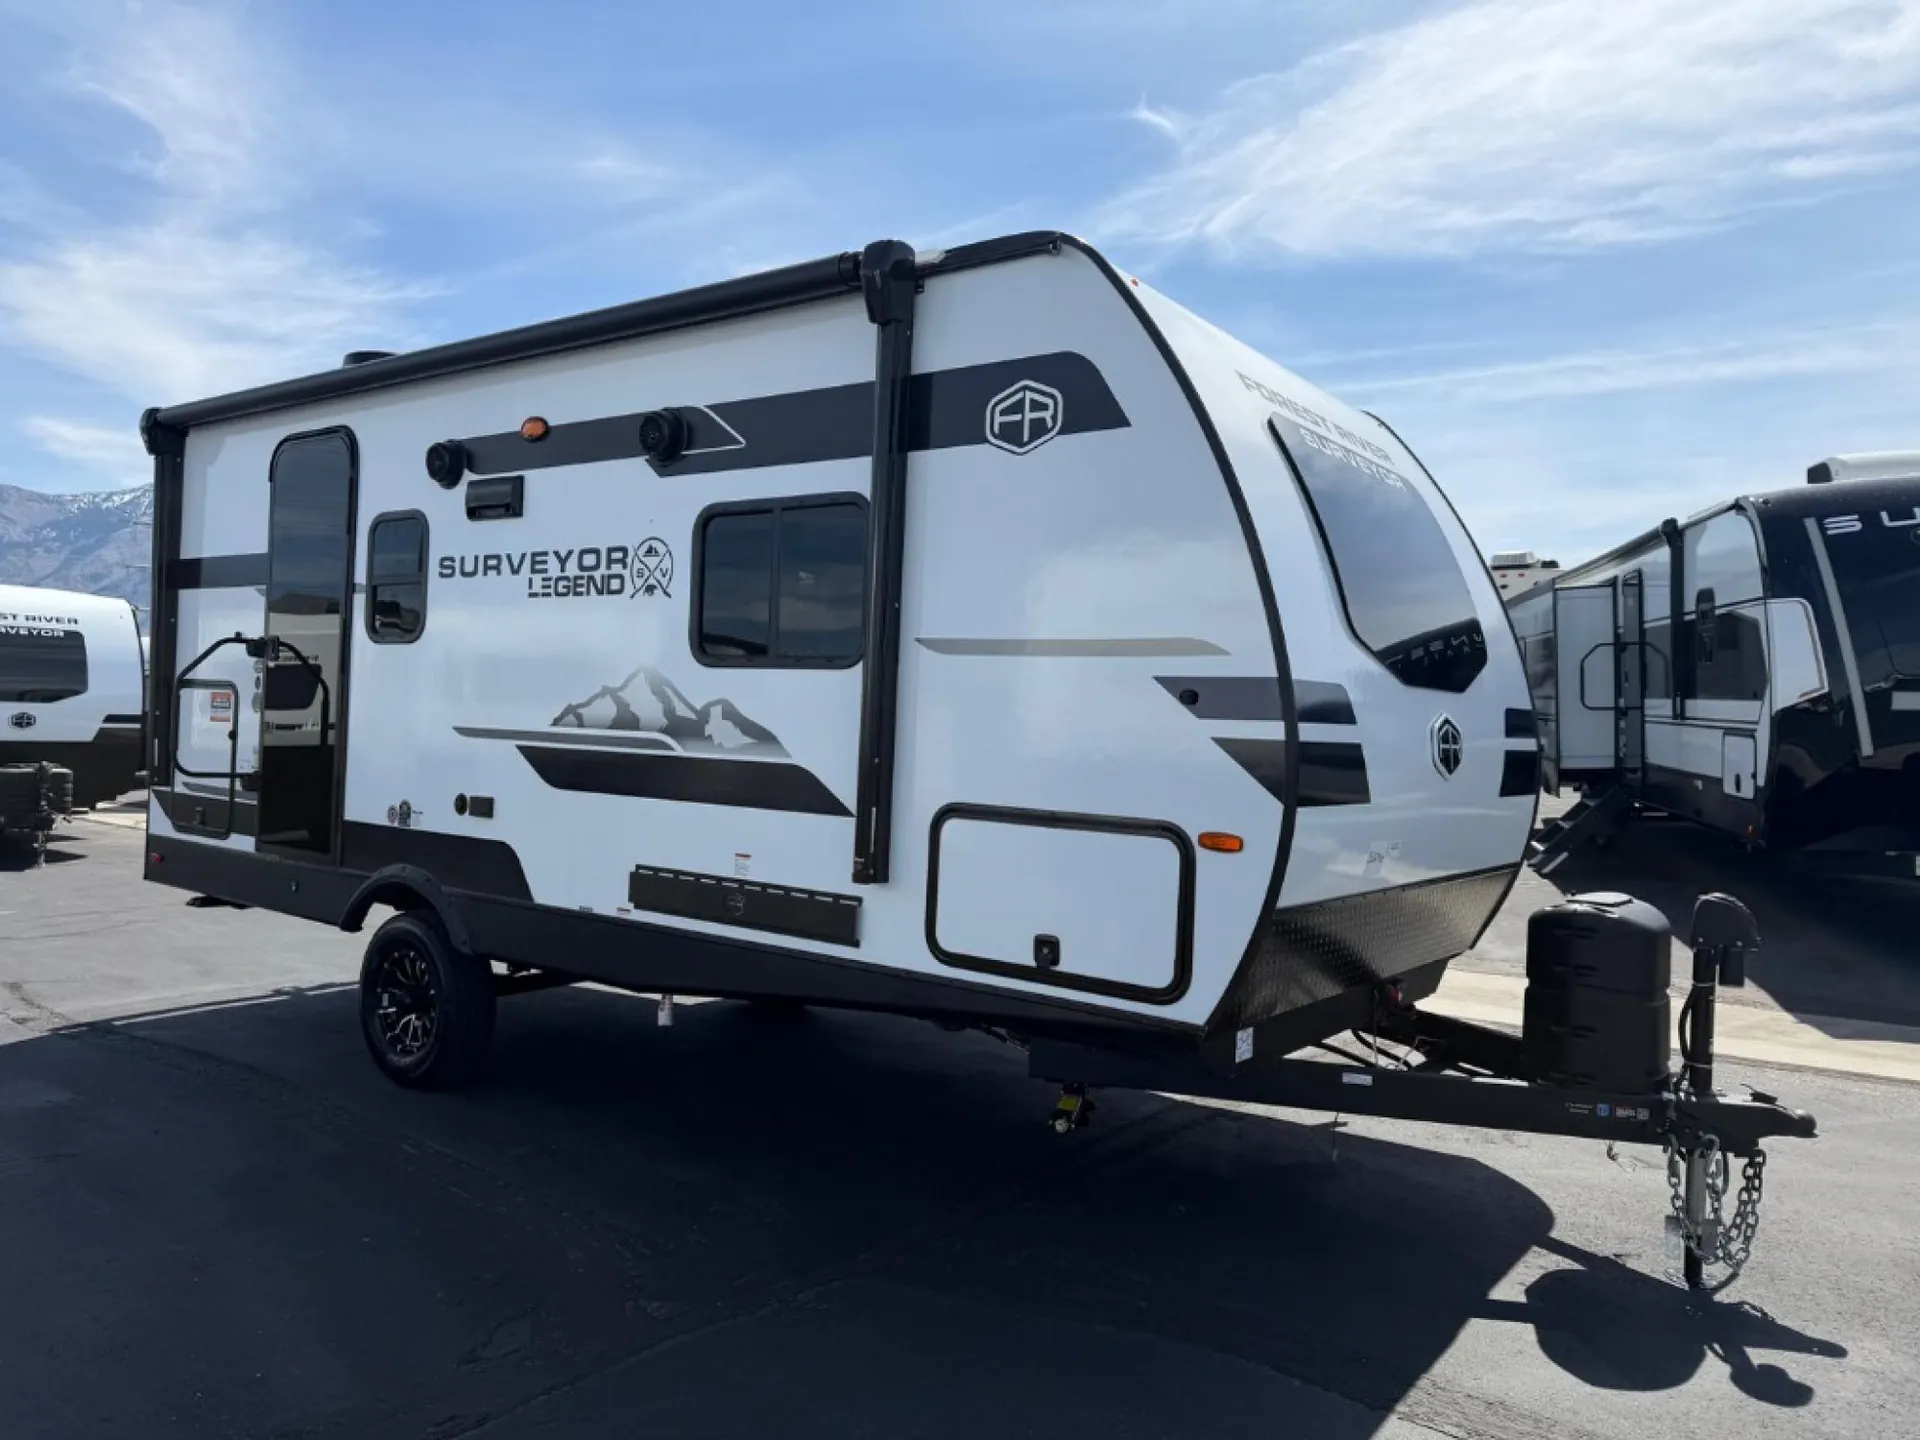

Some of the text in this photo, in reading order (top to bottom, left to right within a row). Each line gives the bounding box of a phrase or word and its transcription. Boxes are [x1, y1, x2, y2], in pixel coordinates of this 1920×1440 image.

[1233, 368, 1395, 466] FOREST RIVER
[438, 545, 629, 578] SURVEYOR
[528, 573, 625, 598] LEGEND
[24, 614, 78, 625] RIVER
